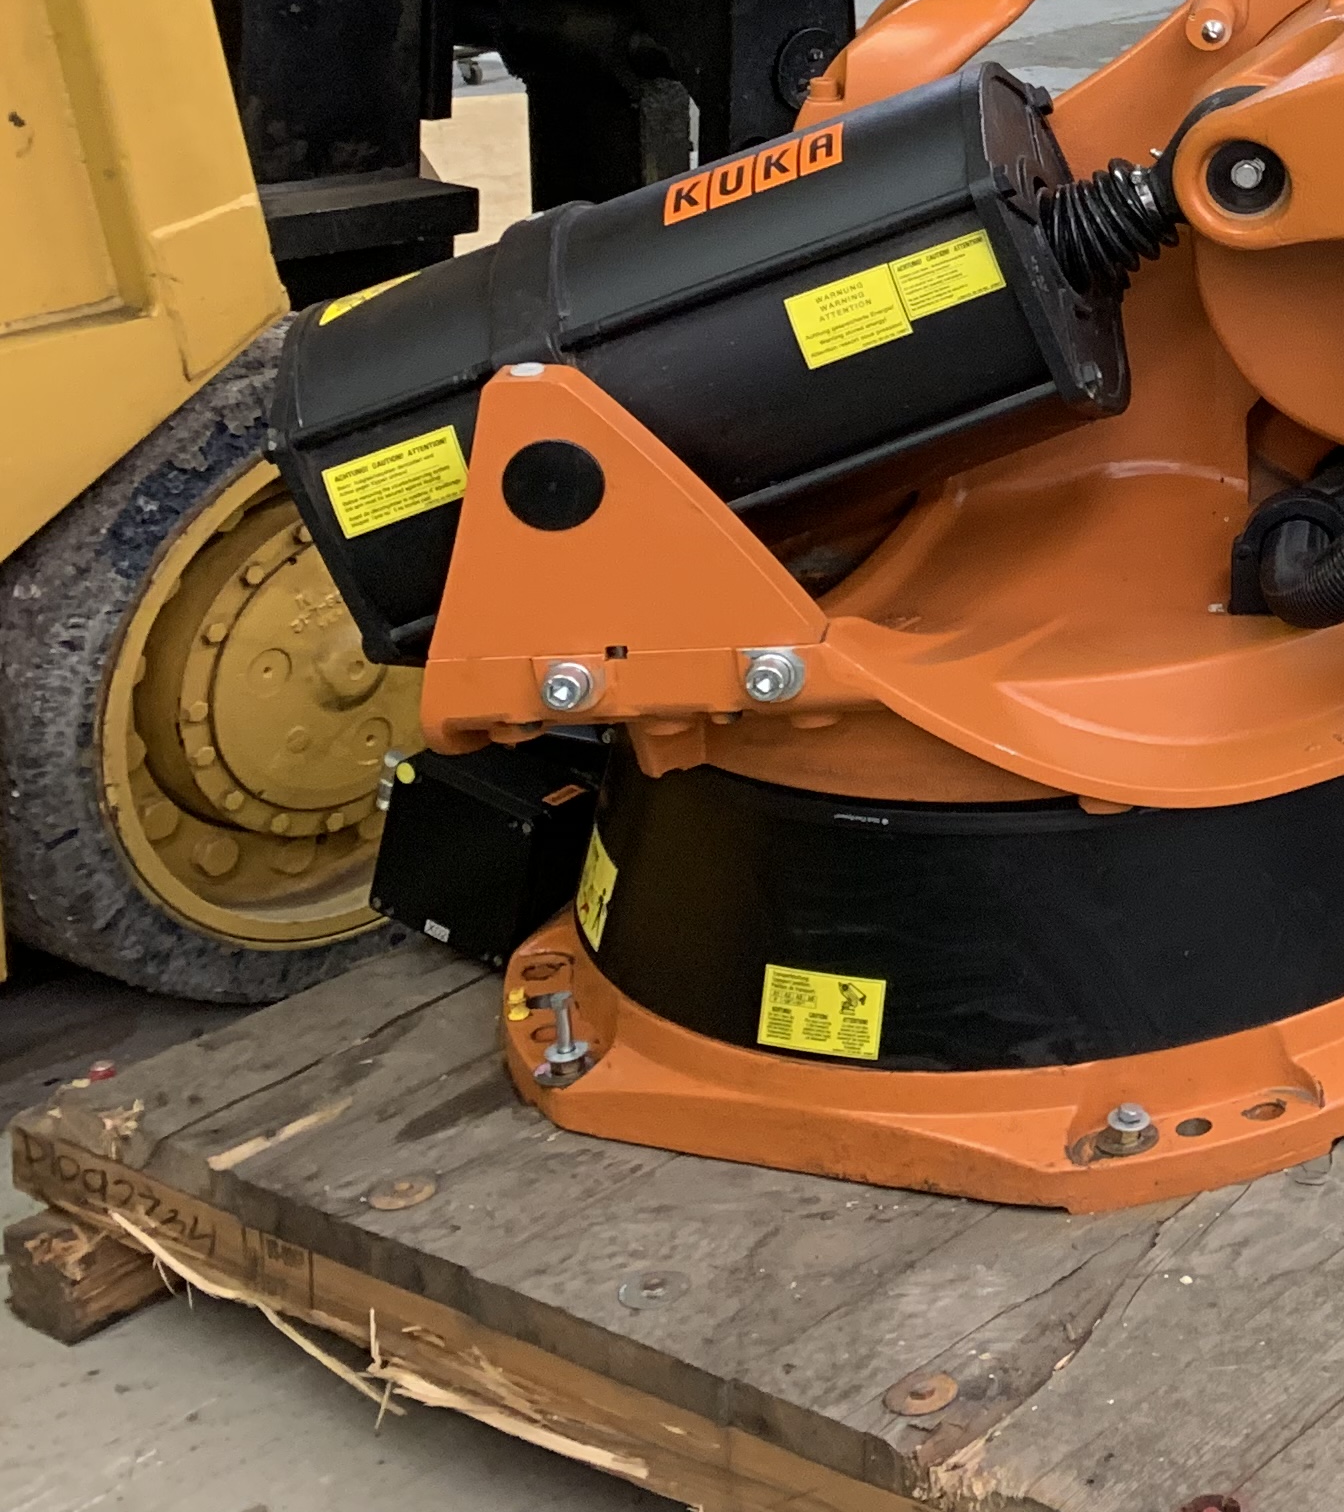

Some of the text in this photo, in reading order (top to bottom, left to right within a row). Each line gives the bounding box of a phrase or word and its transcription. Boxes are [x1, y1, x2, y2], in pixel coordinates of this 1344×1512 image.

[673, 133, 834, 214] KUKA
[816, 282, 864, 304] WARNUNG
[821, 292, 865, 312] WARNING
[819, 299, 872, 322] ATTENTION
